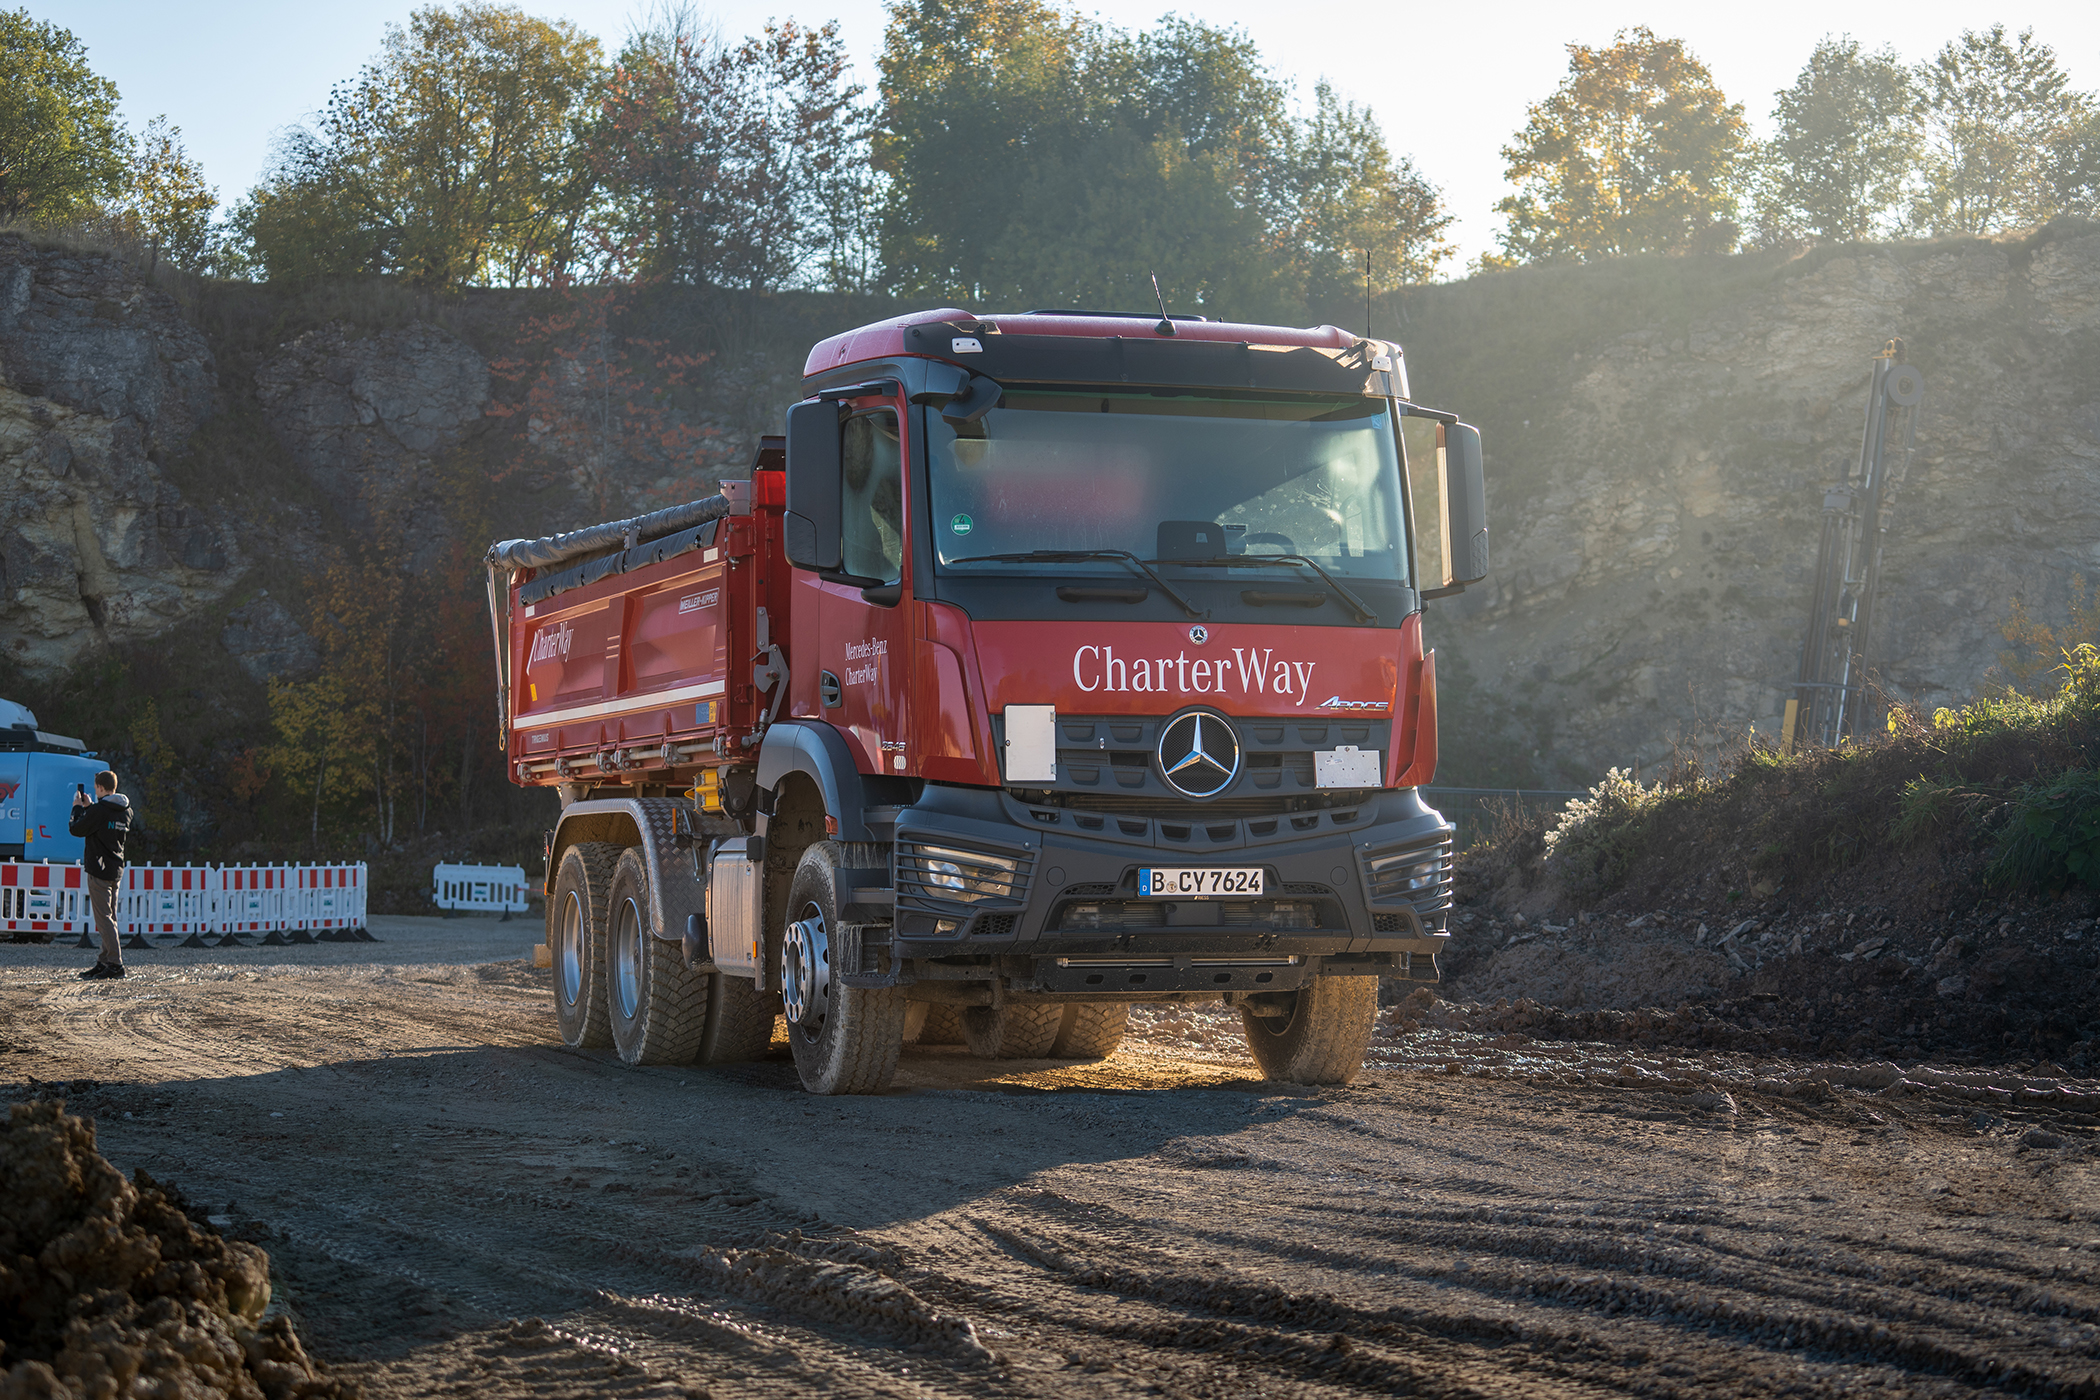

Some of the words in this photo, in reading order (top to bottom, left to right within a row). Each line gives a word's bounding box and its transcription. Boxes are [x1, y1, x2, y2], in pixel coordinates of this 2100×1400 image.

[680, 592, 718, 610] MEILLER-KIPPER
[533, 621, 574, 663] CharterWay
[845, 637, 887, 661] Mercedes-Benz
[845, 663, 877, 686] CharterWay
[1073, 645, 1316, 706] CharterWay
[1152, 871, 1165, 892] B
[1179, 871, 1206, 892] CY
[1210, 871, 1260, 892] 7624
